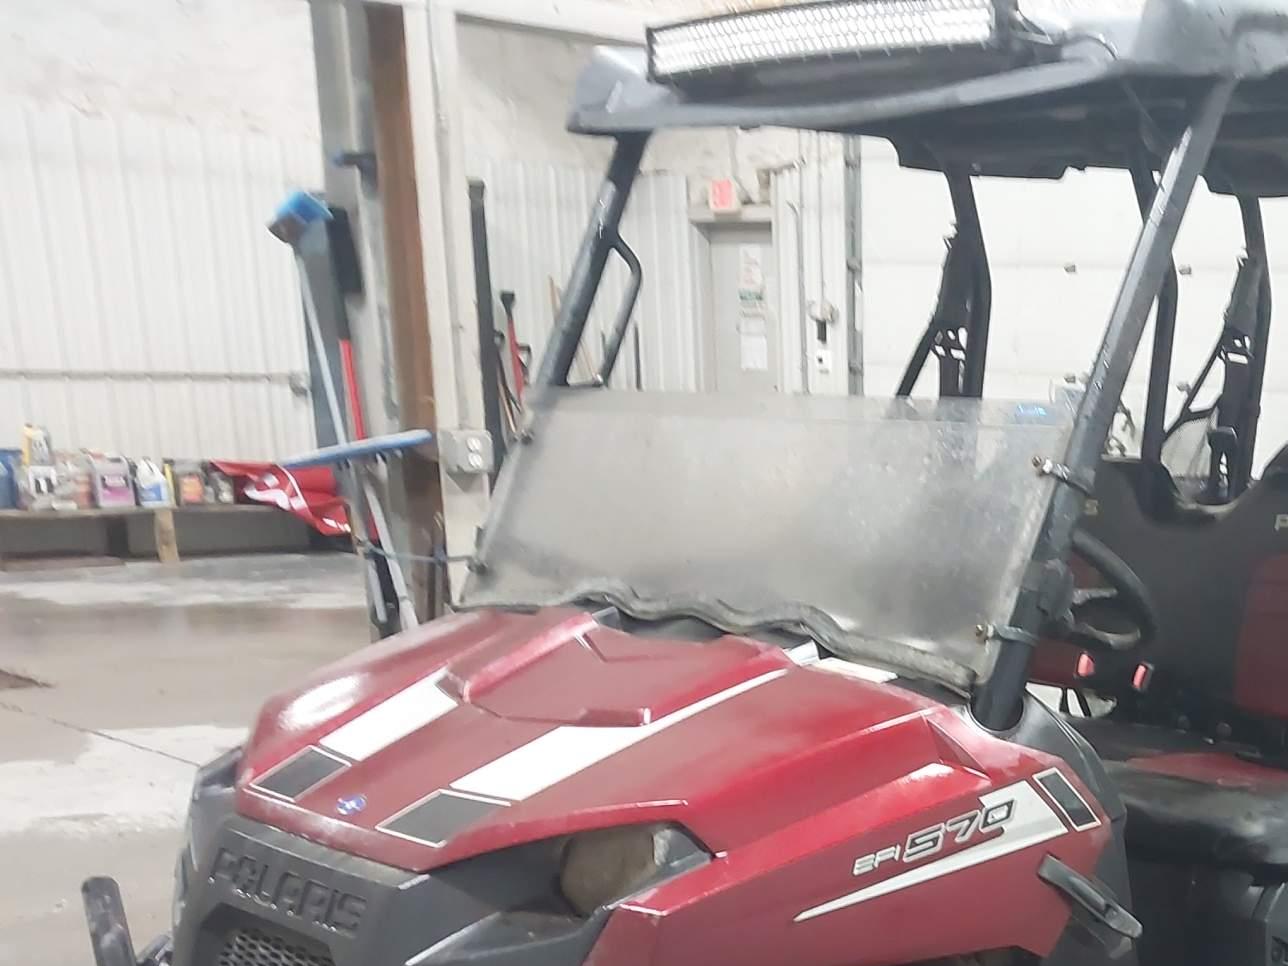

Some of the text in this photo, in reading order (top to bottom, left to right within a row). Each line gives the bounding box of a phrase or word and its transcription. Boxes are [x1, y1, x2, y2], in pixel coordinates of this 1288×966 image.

[852, 798, 1018, 876] EFI 570
[206, 848, 368, 938] POLARIS
